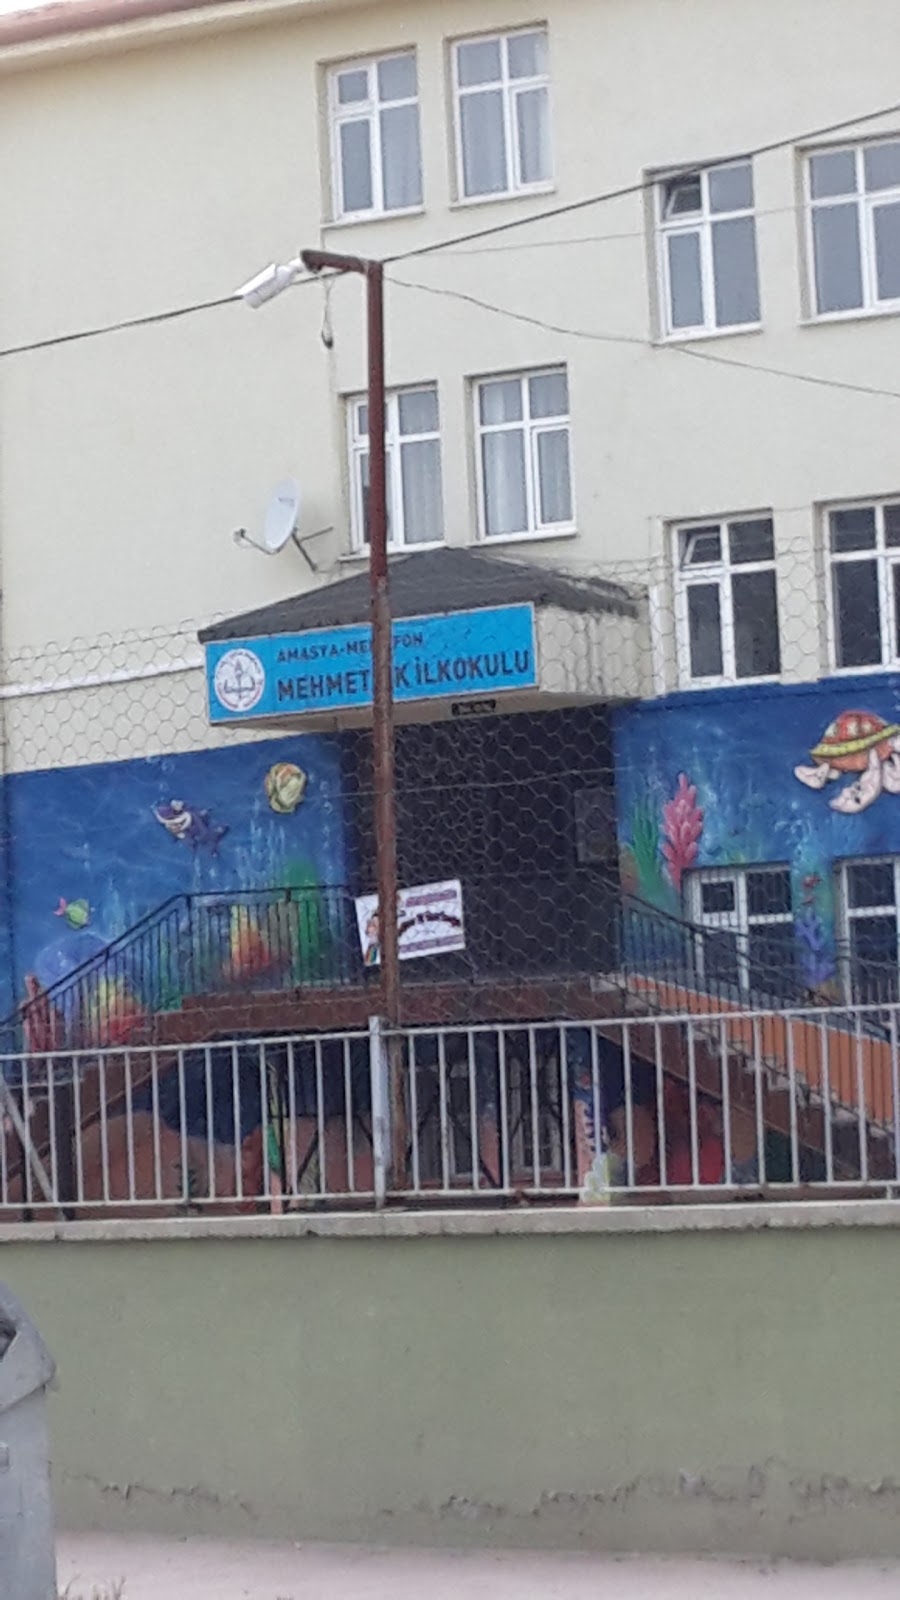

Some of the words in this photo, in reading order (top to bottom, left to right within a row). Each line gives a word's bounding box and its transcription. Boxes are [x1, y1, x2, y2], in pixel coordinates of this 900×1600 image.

[277, 632, 423, 662] AMASYA-MEFON
[277, 662, 412, 702] MEHMETK
[415, 650, 529, 685] İLKOKULU
